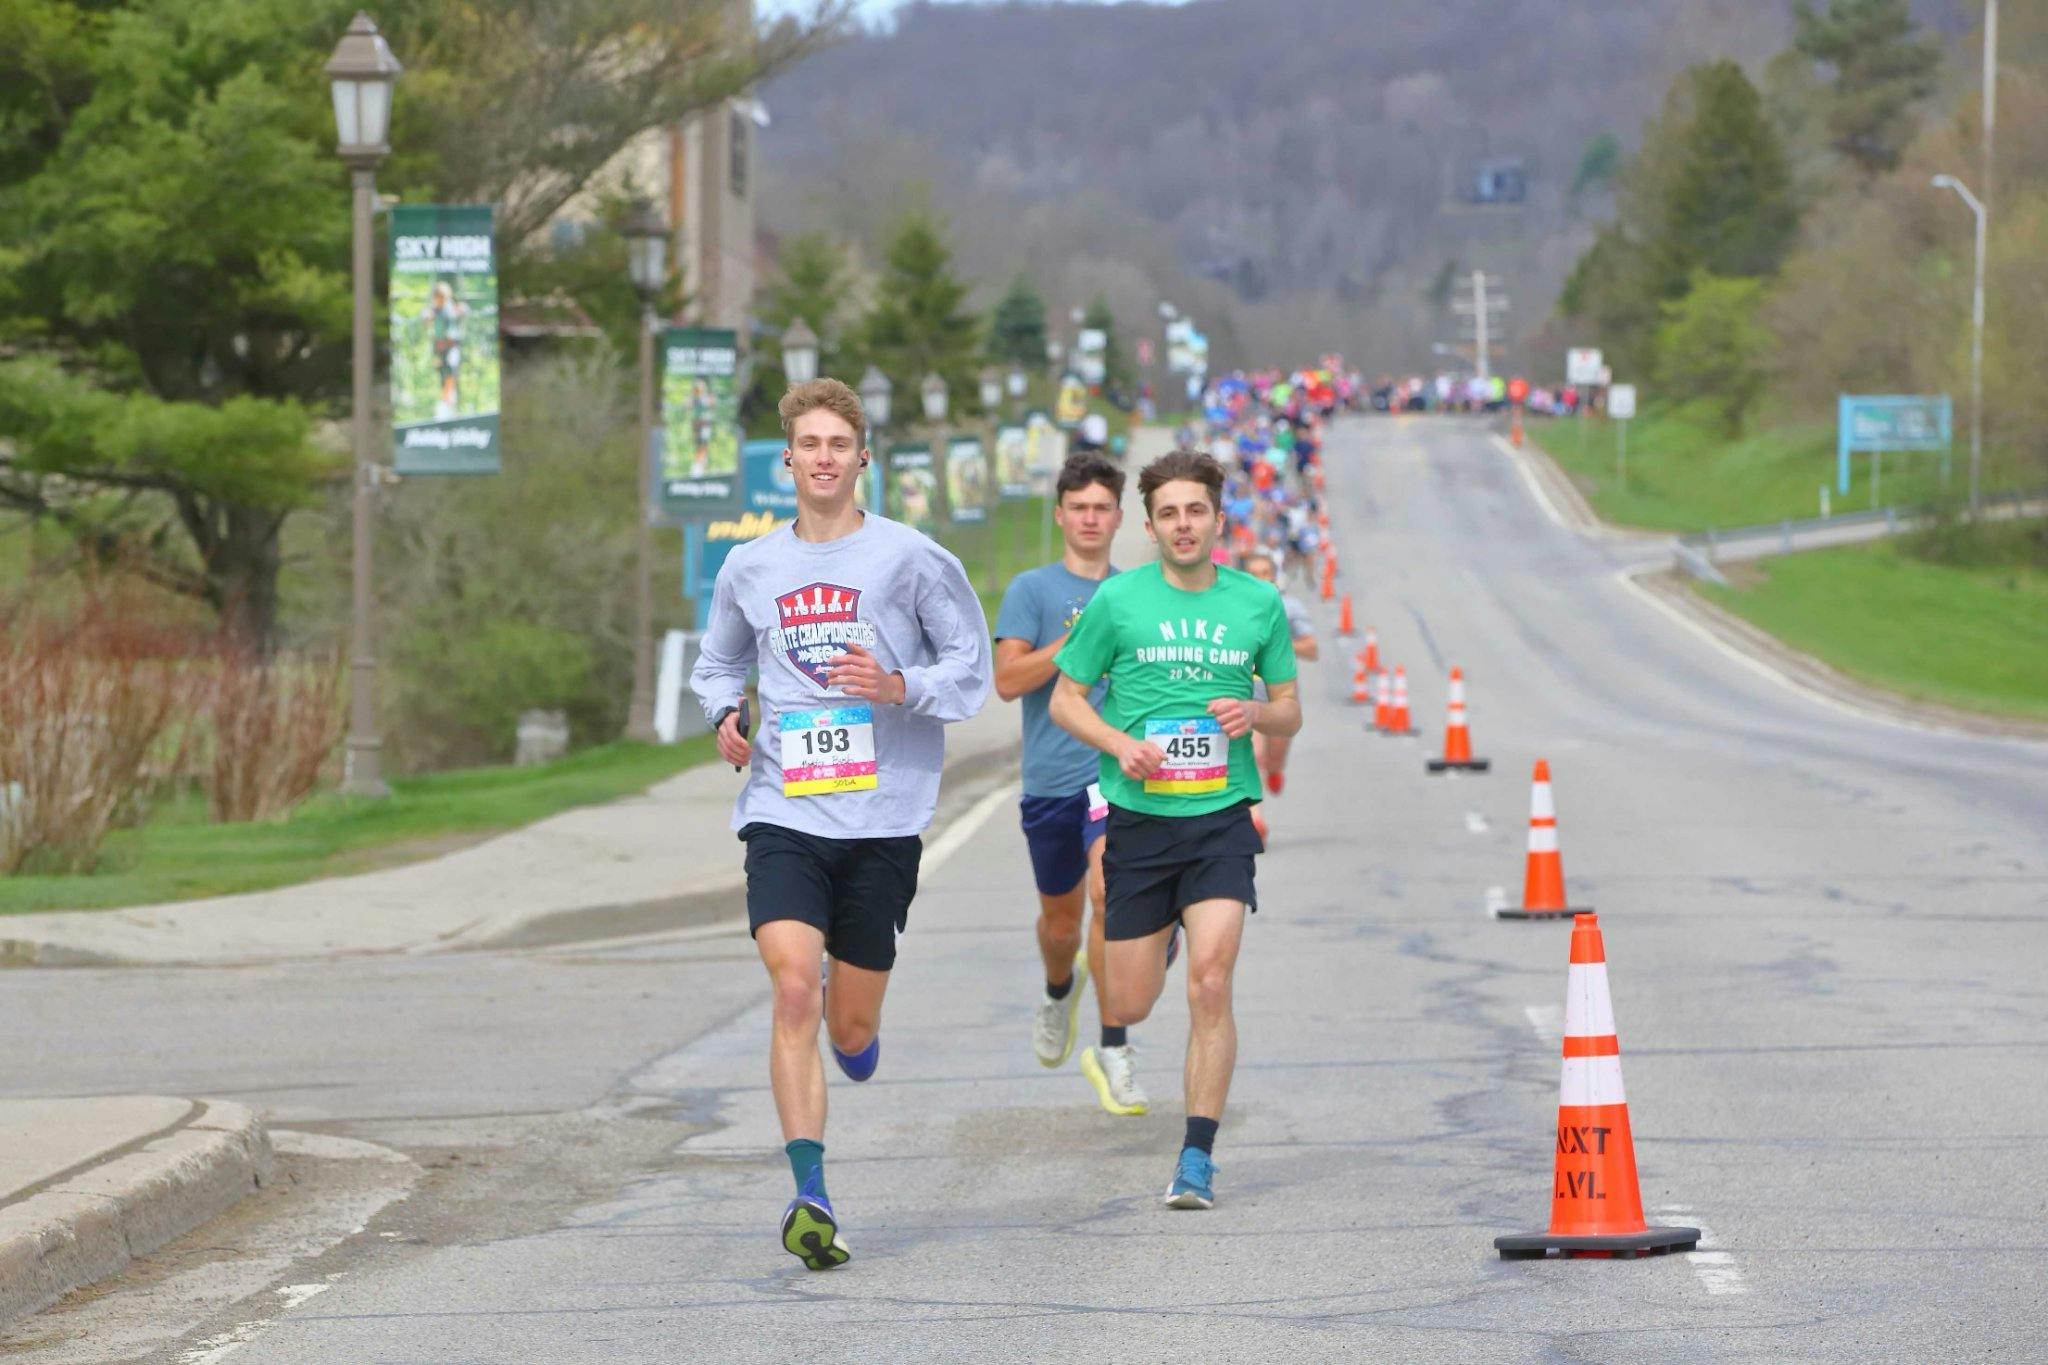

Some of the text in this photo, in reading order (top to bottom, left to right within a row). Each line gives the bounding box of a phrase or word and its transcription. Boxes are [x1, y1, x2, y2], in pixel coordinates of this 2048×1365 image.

[768, 621, 877, 656] STATE CHAMPIONSHIPS
[1159, 618, 1228, 645] NIKE
[1136, 646, 1249, 666] RUNNING CAMP
[1169, 668, 1183, 680] 20
[801, 728, 850, 755] 193
[1166, 737, 1210, 758] 455
